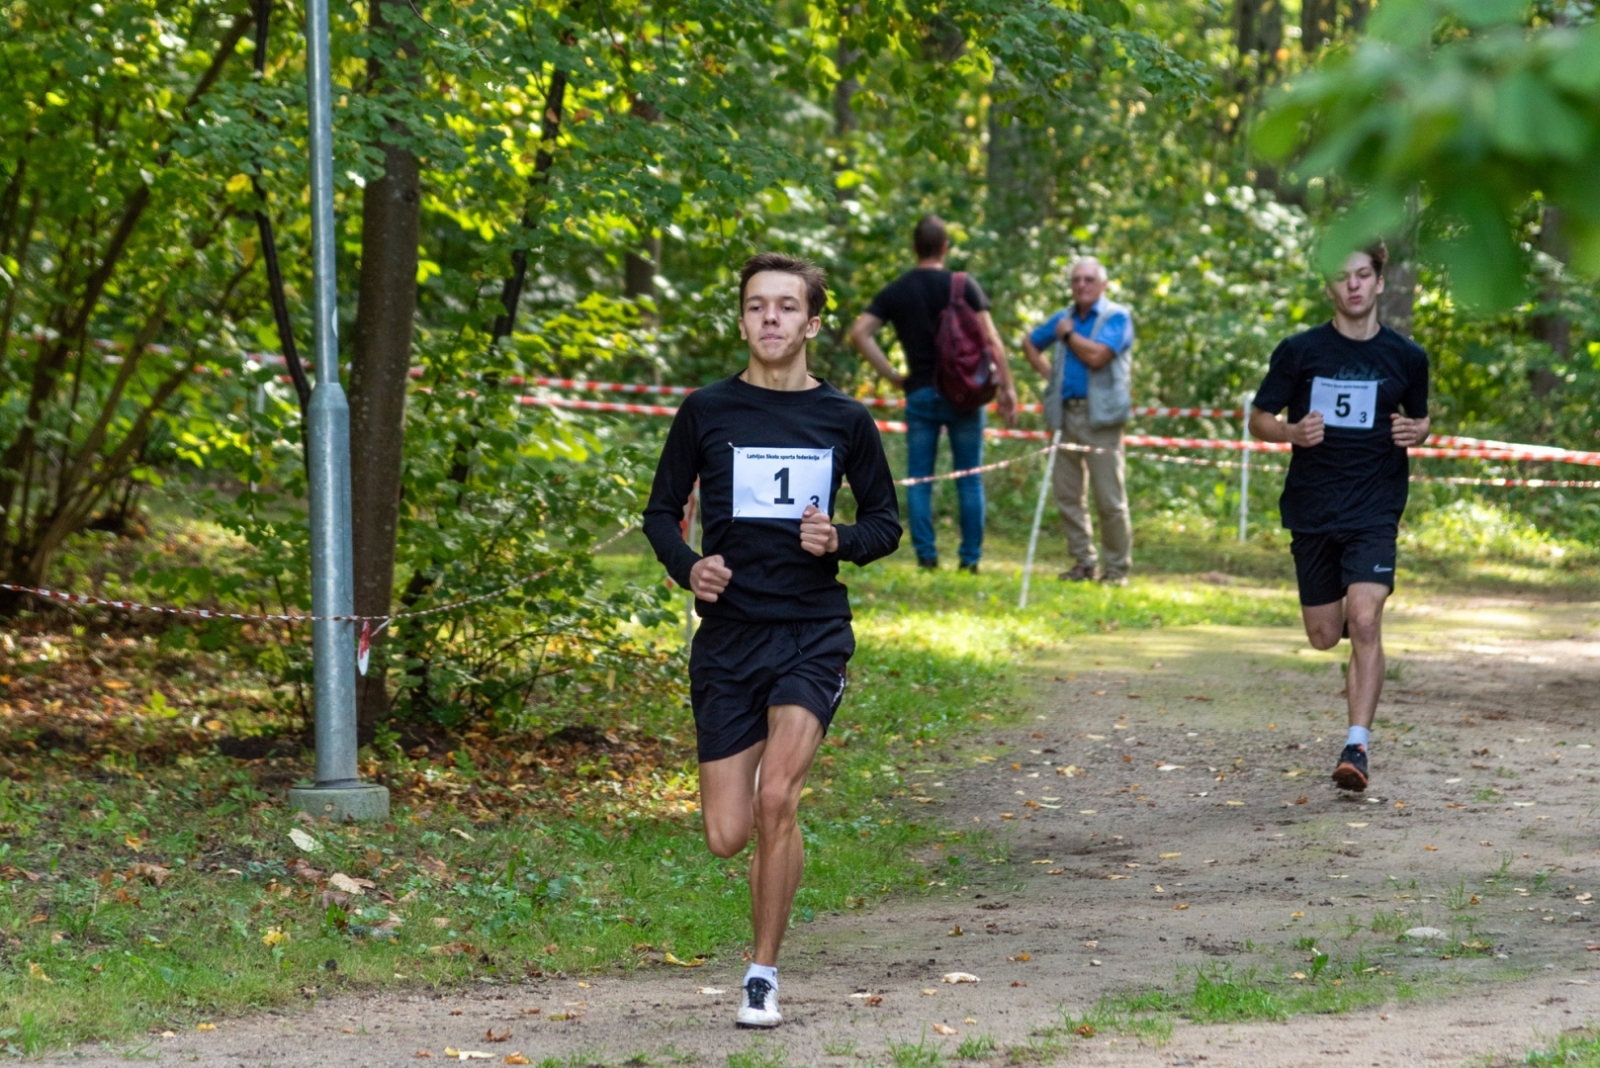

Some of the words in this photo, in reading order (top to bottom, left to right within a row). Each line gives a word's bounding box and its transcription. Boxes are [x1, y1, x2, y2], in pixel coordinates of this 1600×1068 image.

[1335, 393, 1351, 418] 5
[1359, 411, 1368, 424] 3
[774, 467, 795, 505] 1
